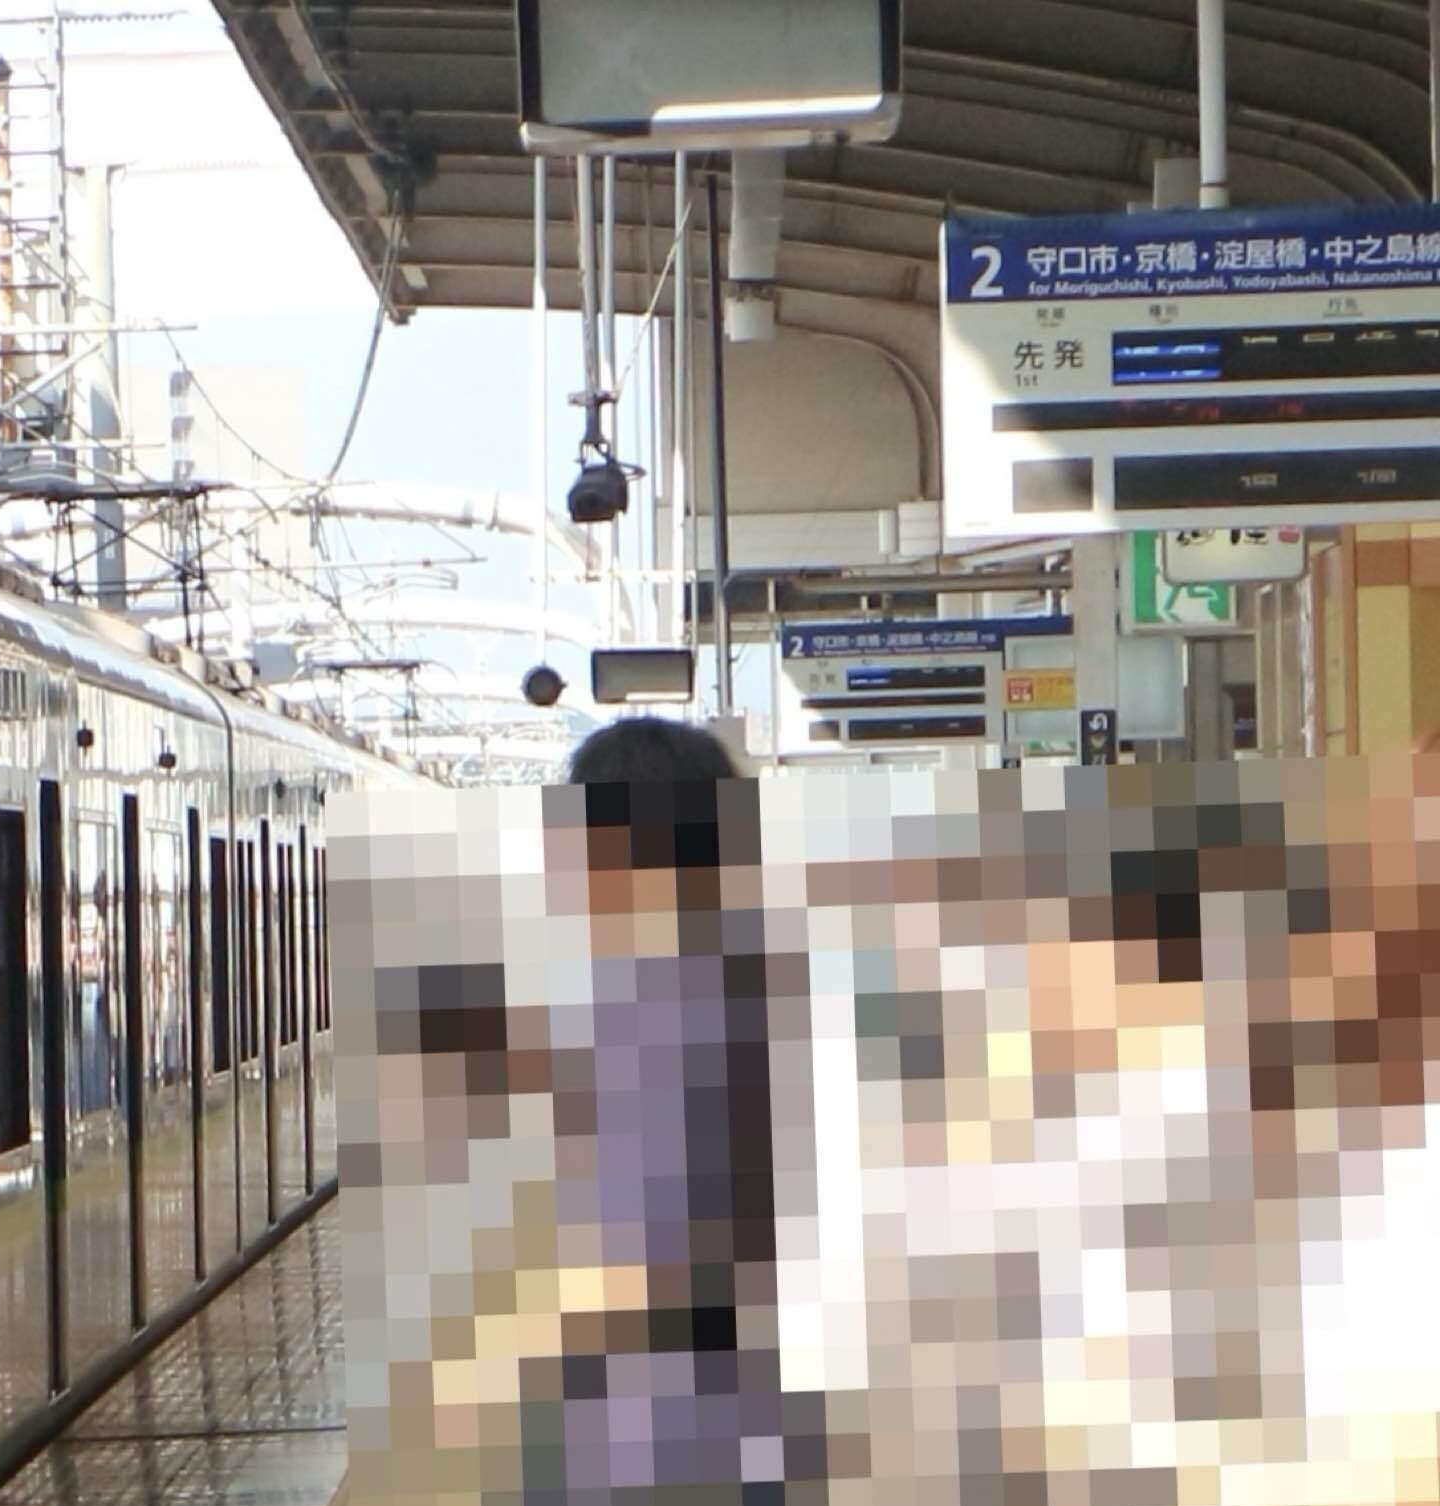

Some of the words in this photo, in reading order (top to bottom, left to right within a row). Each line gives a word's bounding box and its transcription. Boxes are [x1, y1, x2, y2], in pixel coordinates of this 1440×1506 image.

[970, 245, 1005, 298] 2
[1029, 280, 1051, 295] for
[1015, 375, 1039, 387] 1st
[789, 635, 805, 657] 2
